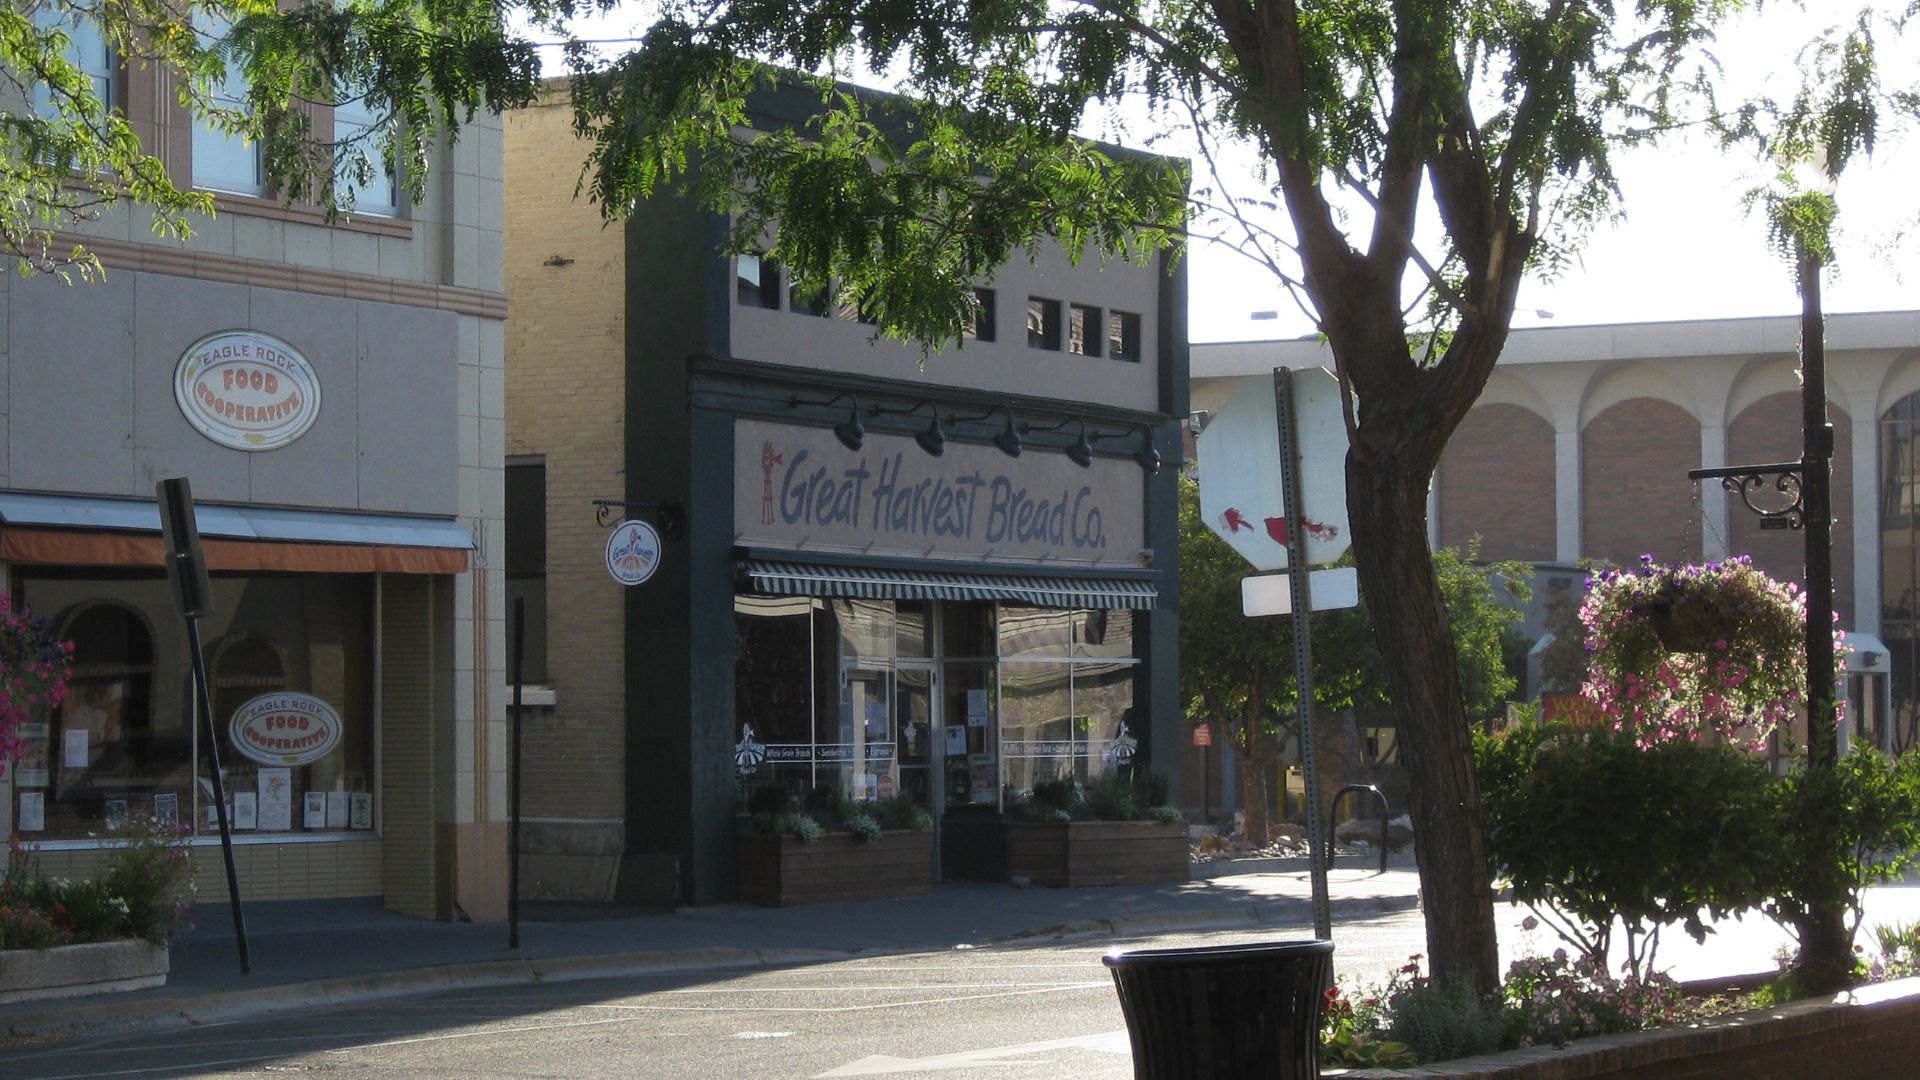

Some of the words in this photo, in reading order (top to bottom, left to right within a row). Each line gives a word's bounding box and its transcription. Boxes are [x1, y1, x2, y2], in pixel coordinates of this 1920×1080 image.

[202, 345, 250, 366] EAGLE
[256, 347, 296, 374] ROCK
[222, 368, 278, 395] FOOD
[196, 381, 300, 423] COOPERATIVE
[780, 449, 870, 528] Great
[873, 452, 985, 540] Harvest
[985, 475, 1069, 547] Bread
[1071, 486, 1106, 549] Co.
[250, 700, 287, 716] EAGLE
[291, 700, 322, 714] ROCK
[1552, 697, 1604, 711] WELL
[264, 715, 310, 731] FOOD
[245, 726, 328, 750] COOPERATIVE
